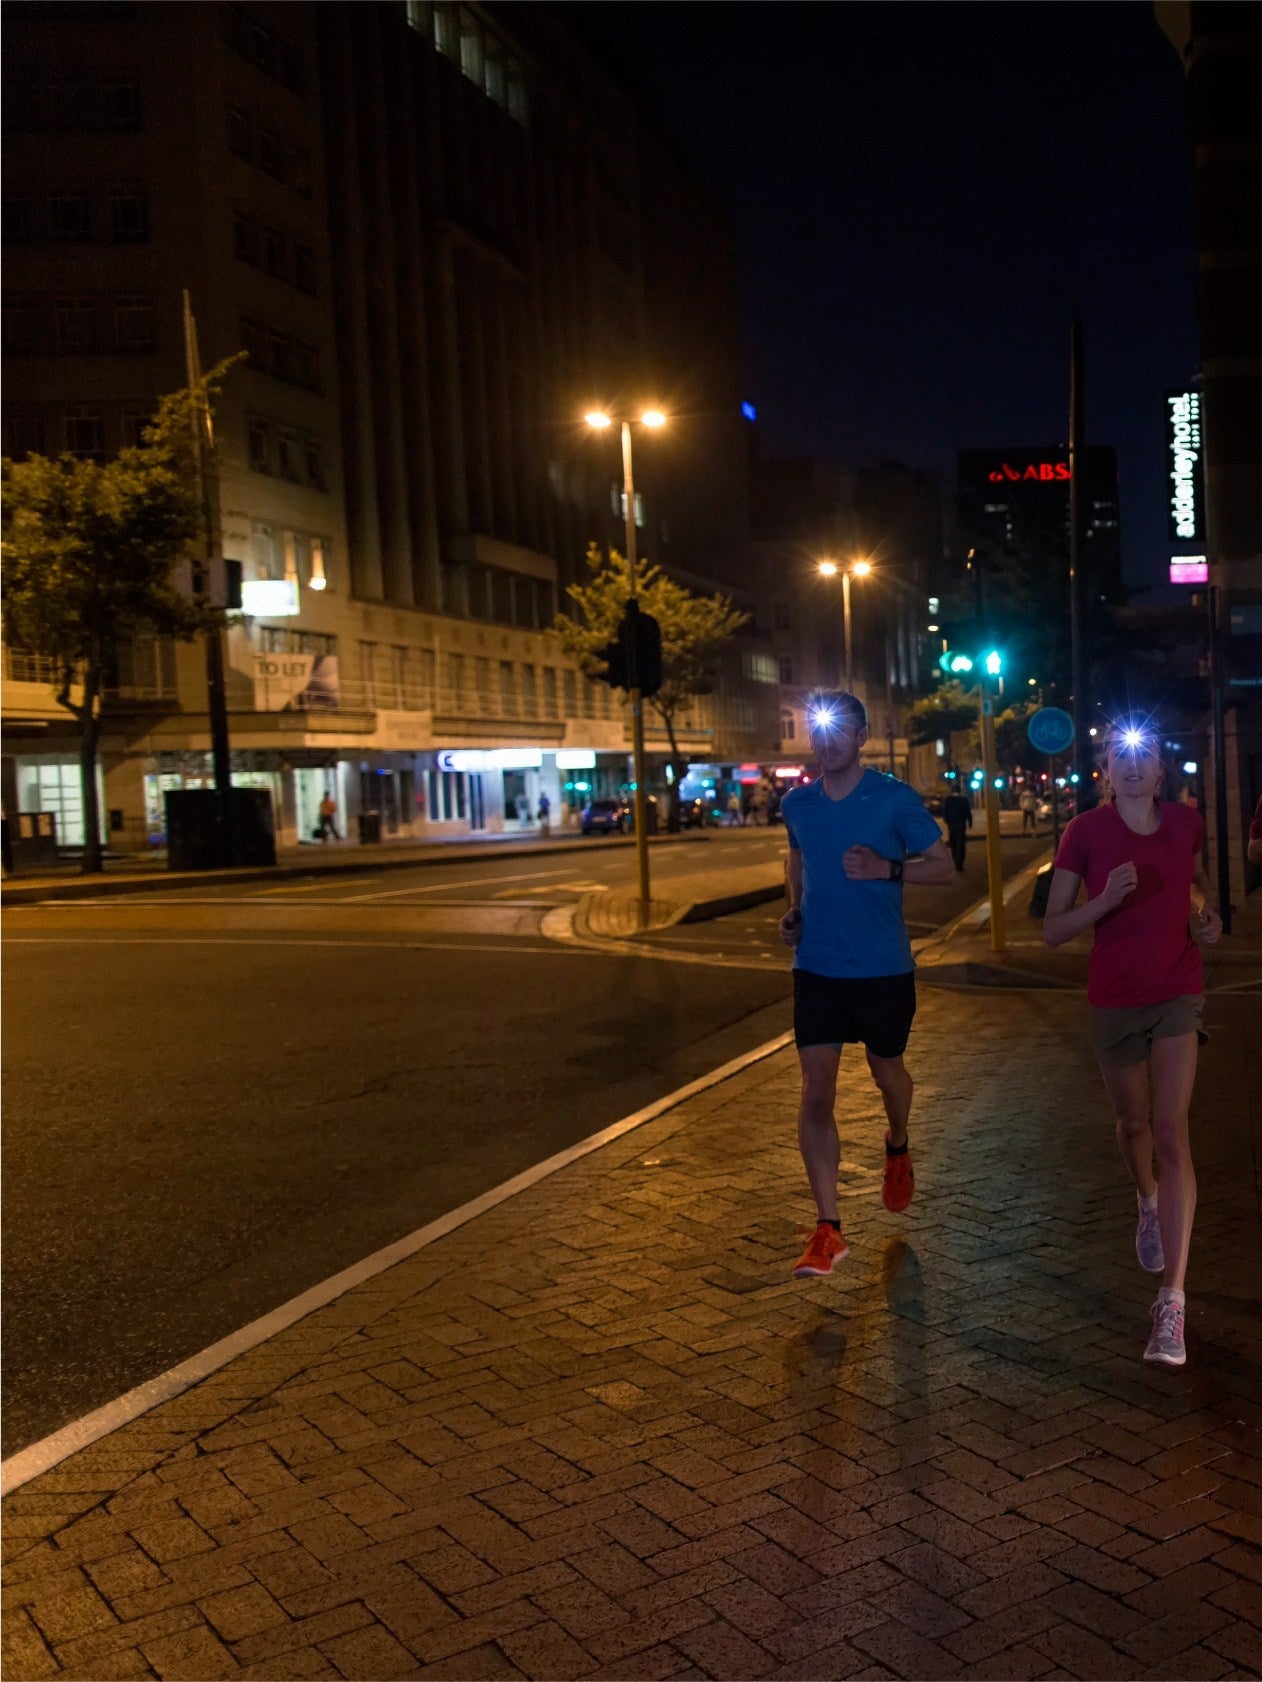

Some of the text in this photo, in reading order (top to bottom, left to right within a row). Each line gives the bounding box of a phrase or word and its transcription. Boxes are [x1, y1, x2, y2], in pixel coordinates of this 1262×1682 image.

[1023, 463, 1072, 481] ABS
[258, 661, 307, 677] TO LET
